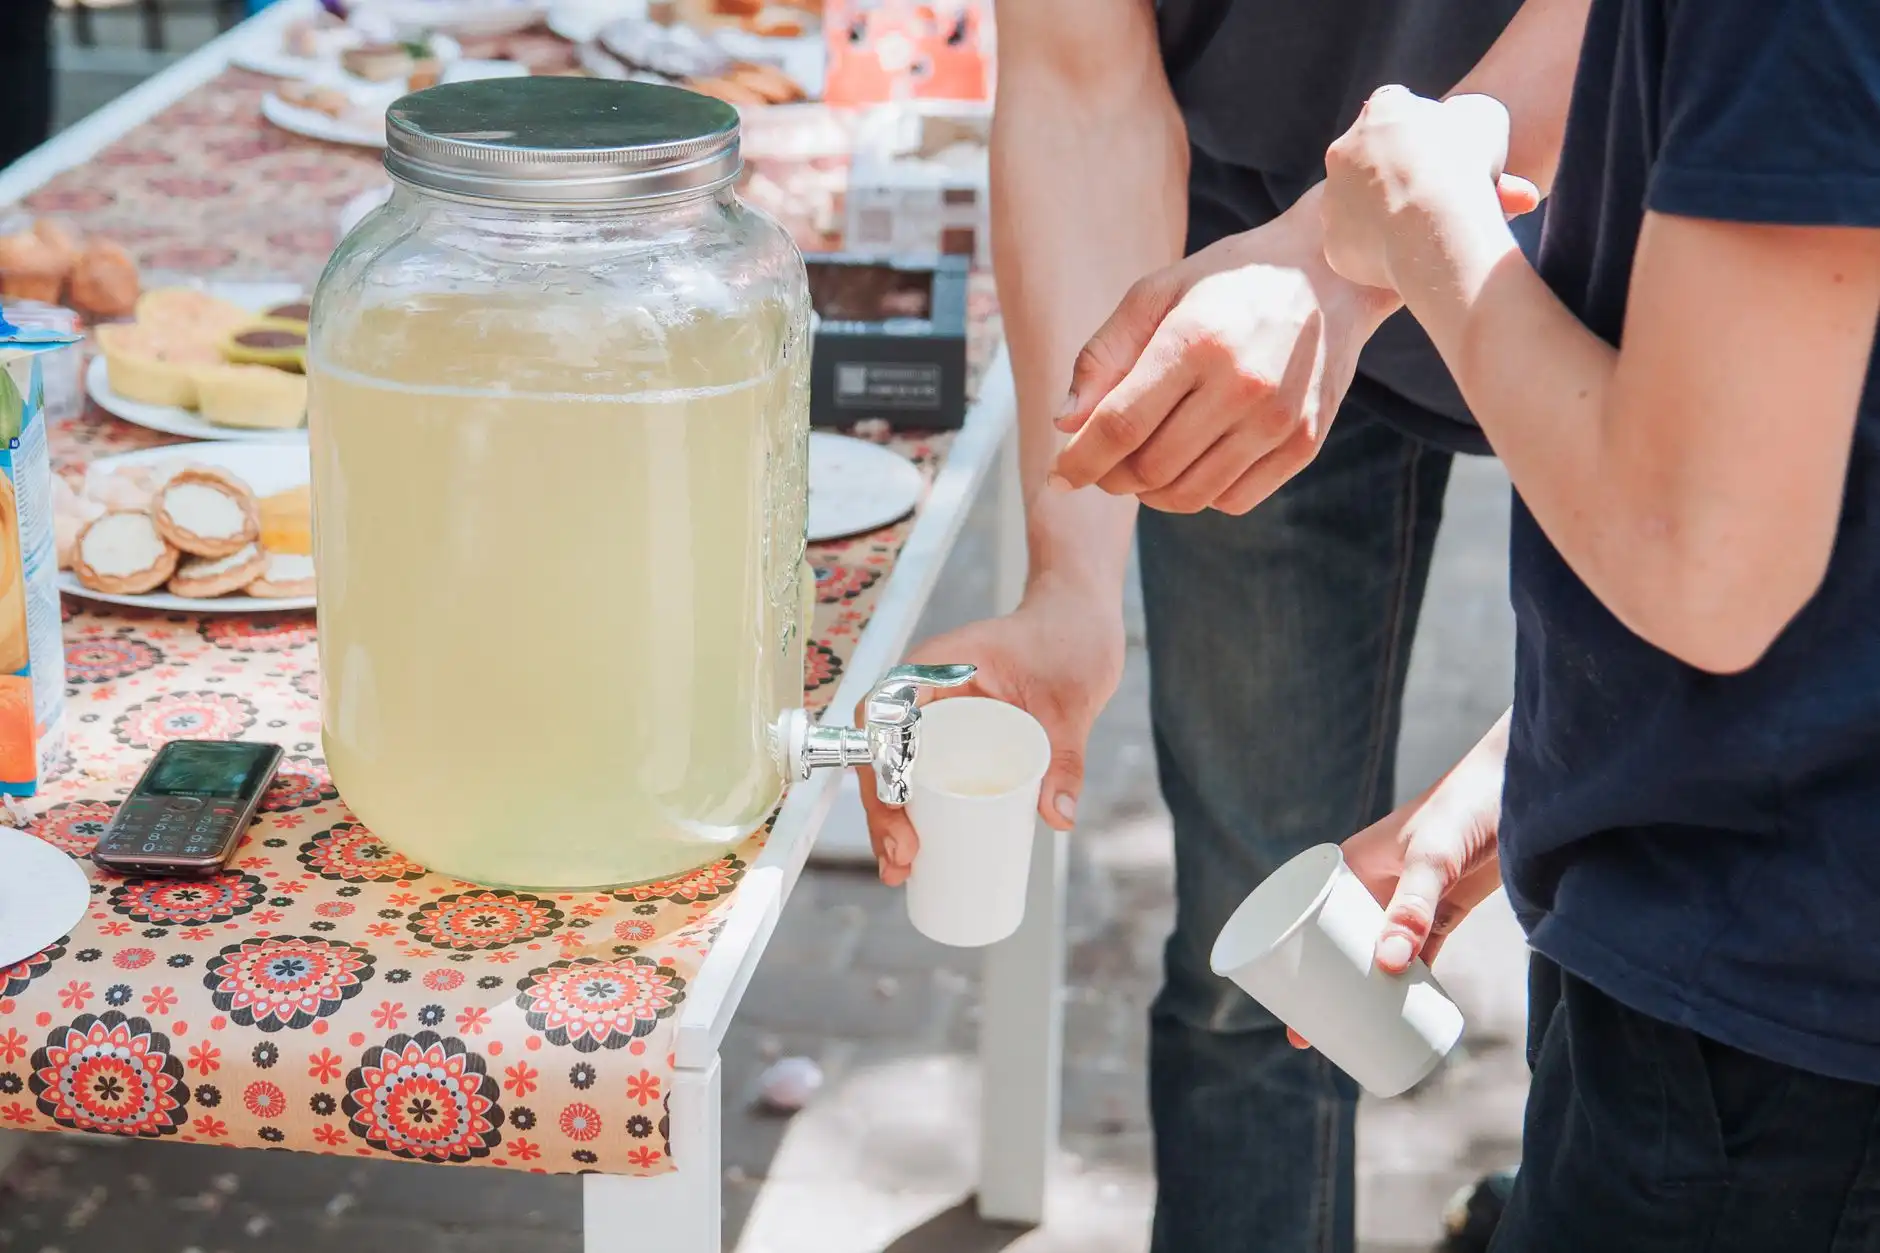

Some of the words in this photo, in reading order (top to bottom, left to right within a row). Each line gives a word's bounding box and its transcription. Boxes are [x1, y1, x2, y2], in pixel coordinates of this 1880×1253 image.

[160, 814, 172, 822] 2
[200, 815, 212, 824] 3
[154, 823, 168, 831] 5
[196, 825, 207, 833] 6
[109, 832, 120, 840] 7
[148, 832, 160, 841] 8
[190, 834, 202, 843] 9
[142, 842, 156, 852] 0
